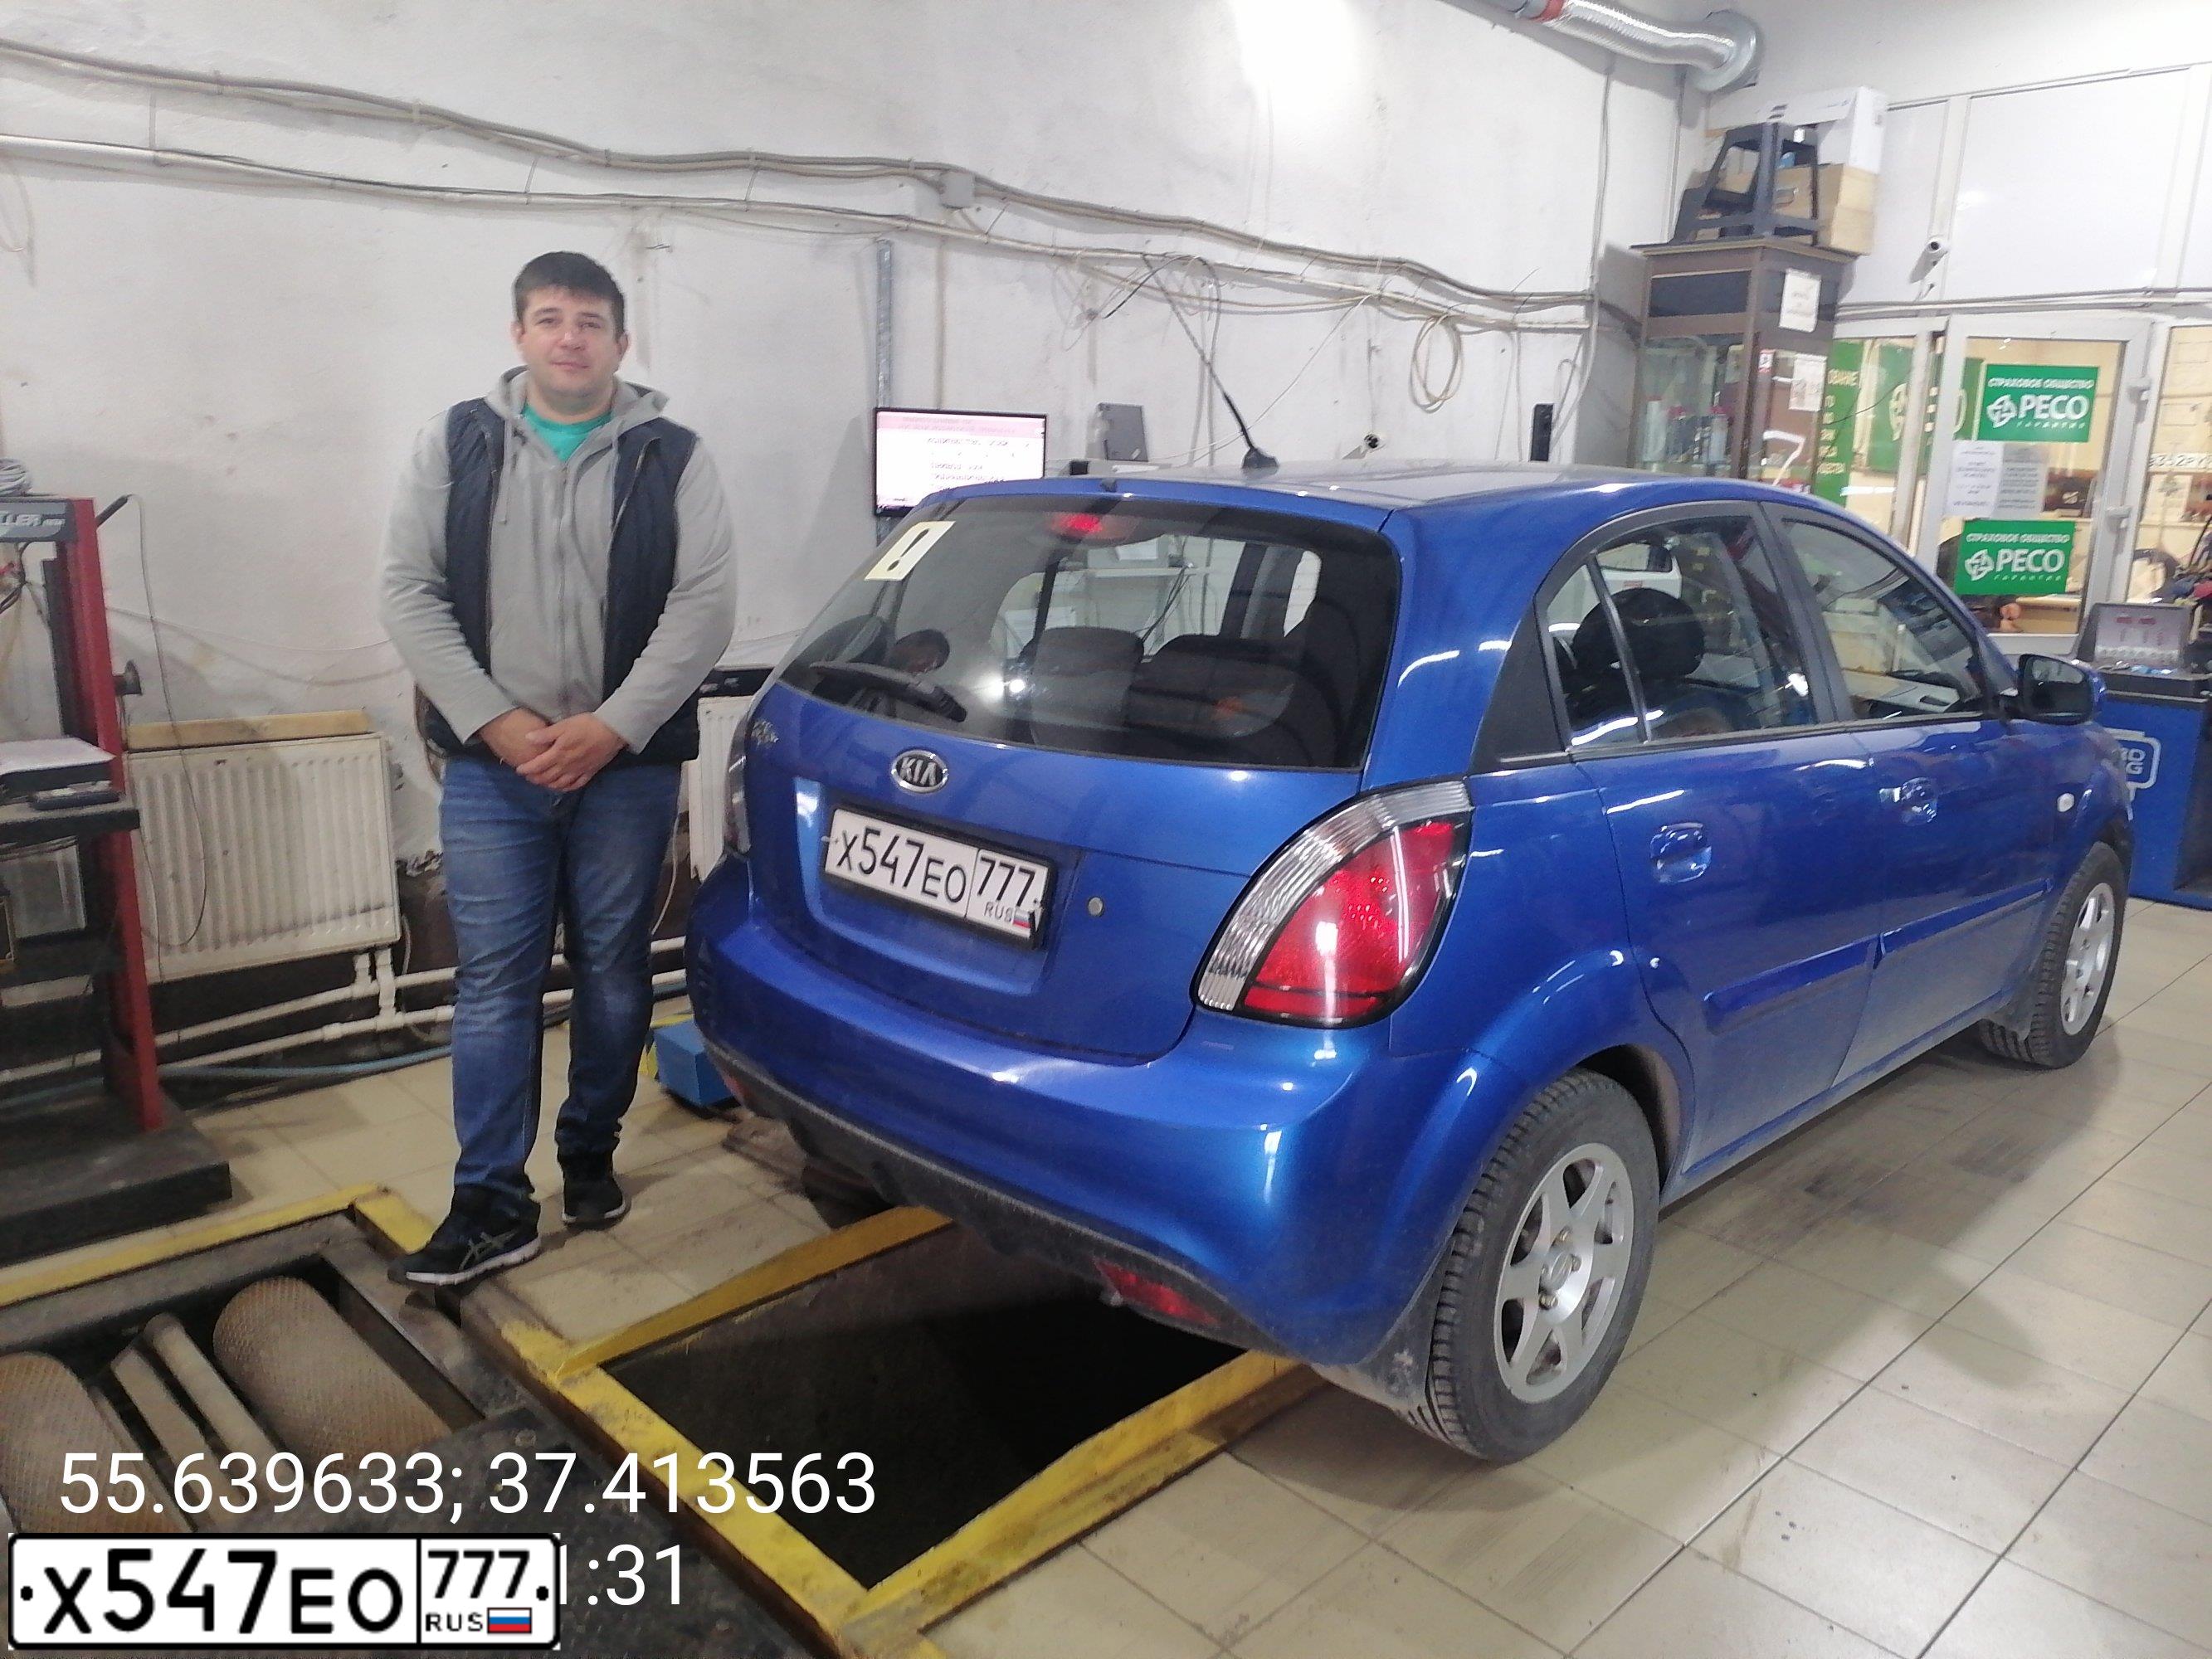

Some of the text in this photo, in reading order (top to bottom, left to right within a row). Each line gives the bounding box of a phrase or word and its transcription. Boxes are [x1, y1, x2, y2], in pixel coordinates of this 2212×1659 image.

[2018, 394, 2090, 420] РЕСО
[1995, 548, 2065, 573] РЕСО
[900, 756, 938, 787] KIA
[977, 856, 1036, 907] 777
